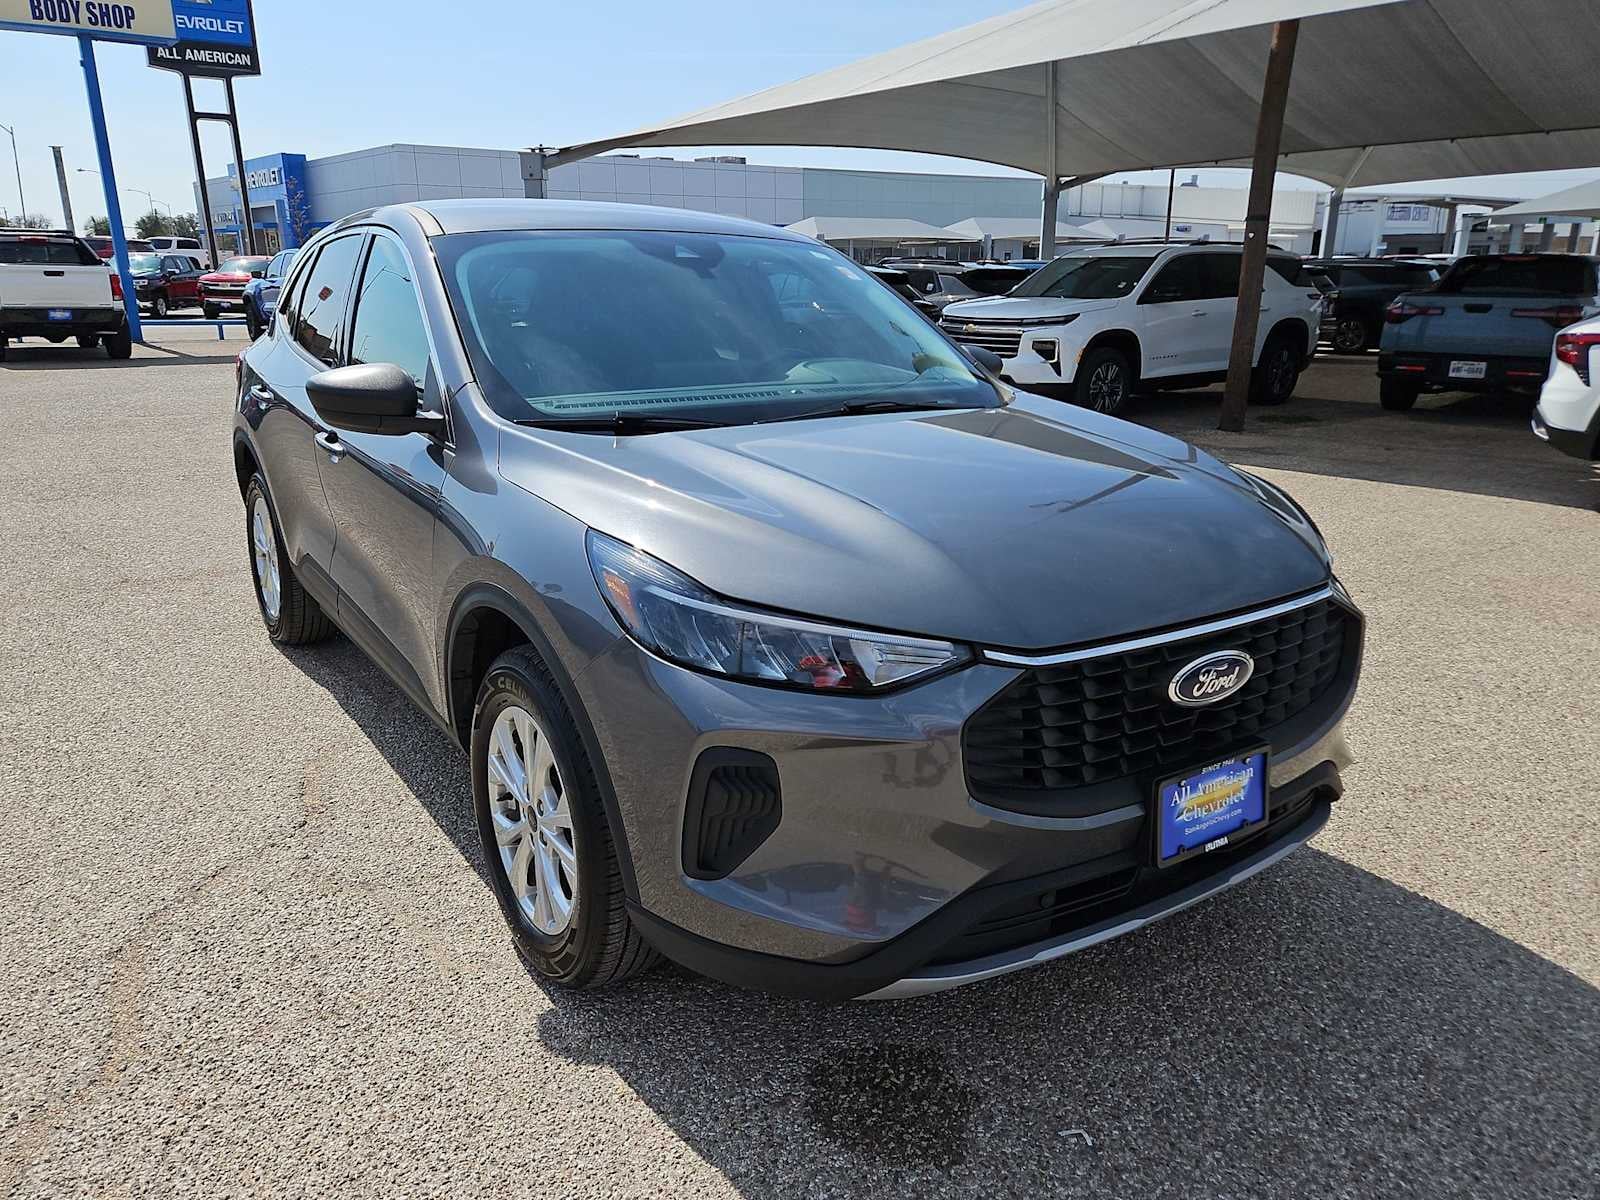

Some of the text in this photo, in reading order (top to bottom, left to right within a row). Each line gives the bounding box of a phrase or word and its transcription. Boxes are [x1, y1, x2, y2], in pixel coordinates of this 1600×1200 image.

[29, 0, 136, 29] BODY SHOP
[175, 14, 244, 33] EVROLET
[158, 47, 252, 66] ALL AMERICAN
[247, 167, 279, 190] EVROLET
[1193, 662, 1240, 697] Ford
[1170, 766, 1254, 807] All American
[1183, 788, 1245, 822] Chevrolet
